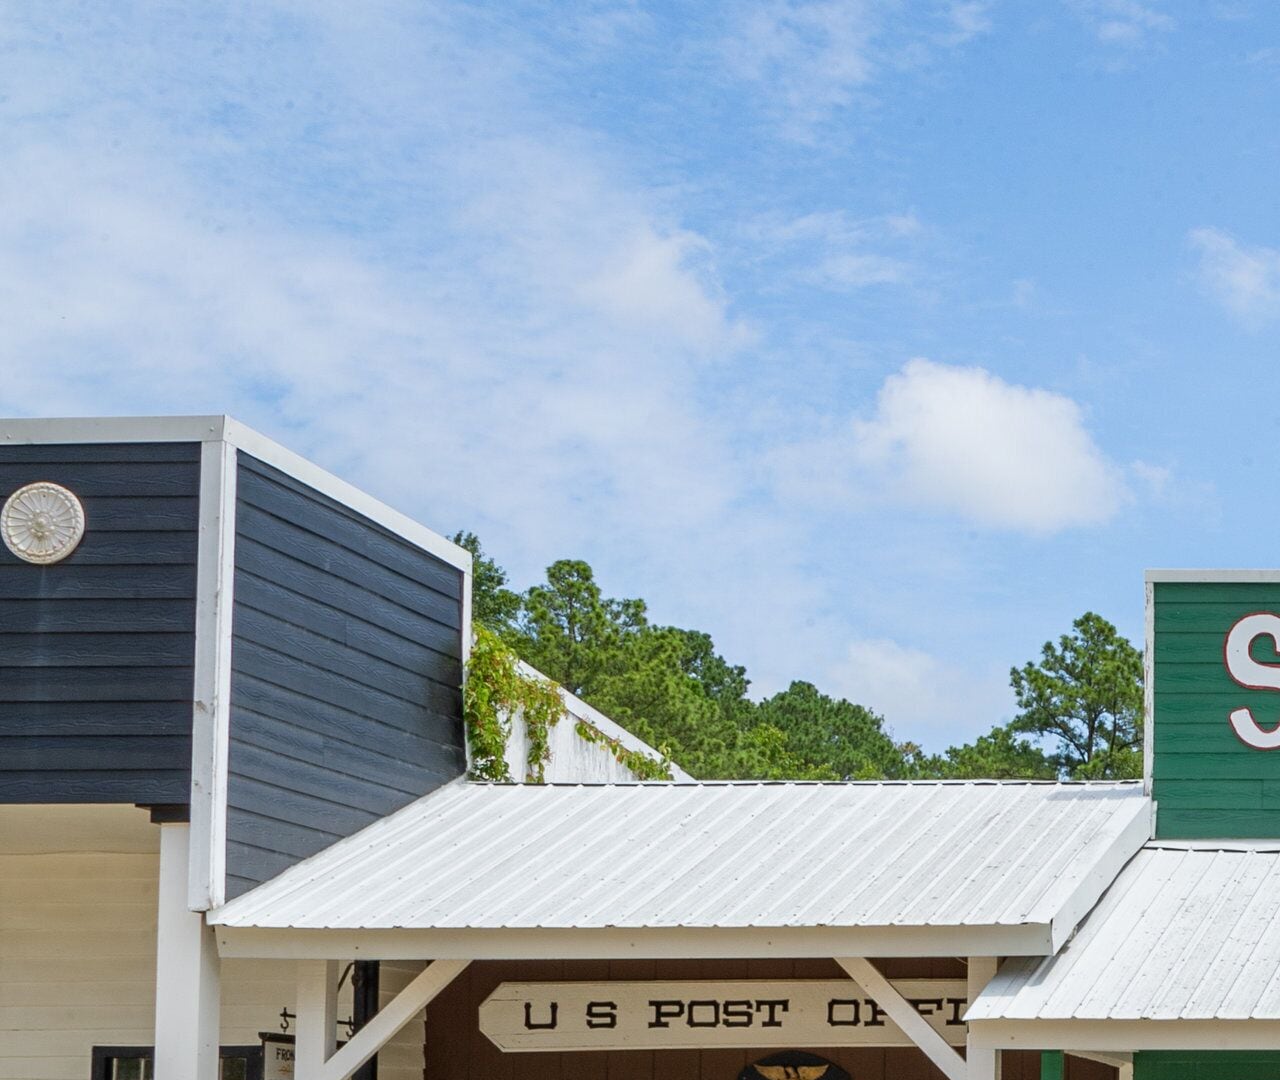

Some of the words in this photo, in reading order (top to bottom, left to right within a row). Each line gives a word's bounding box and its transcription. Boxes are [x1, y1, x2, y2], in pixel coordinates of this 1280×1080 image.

[524, 1001, 558, 1030] U
[586, 1001, 617, 1029] S
[648, 999, 790, 1029] POST
